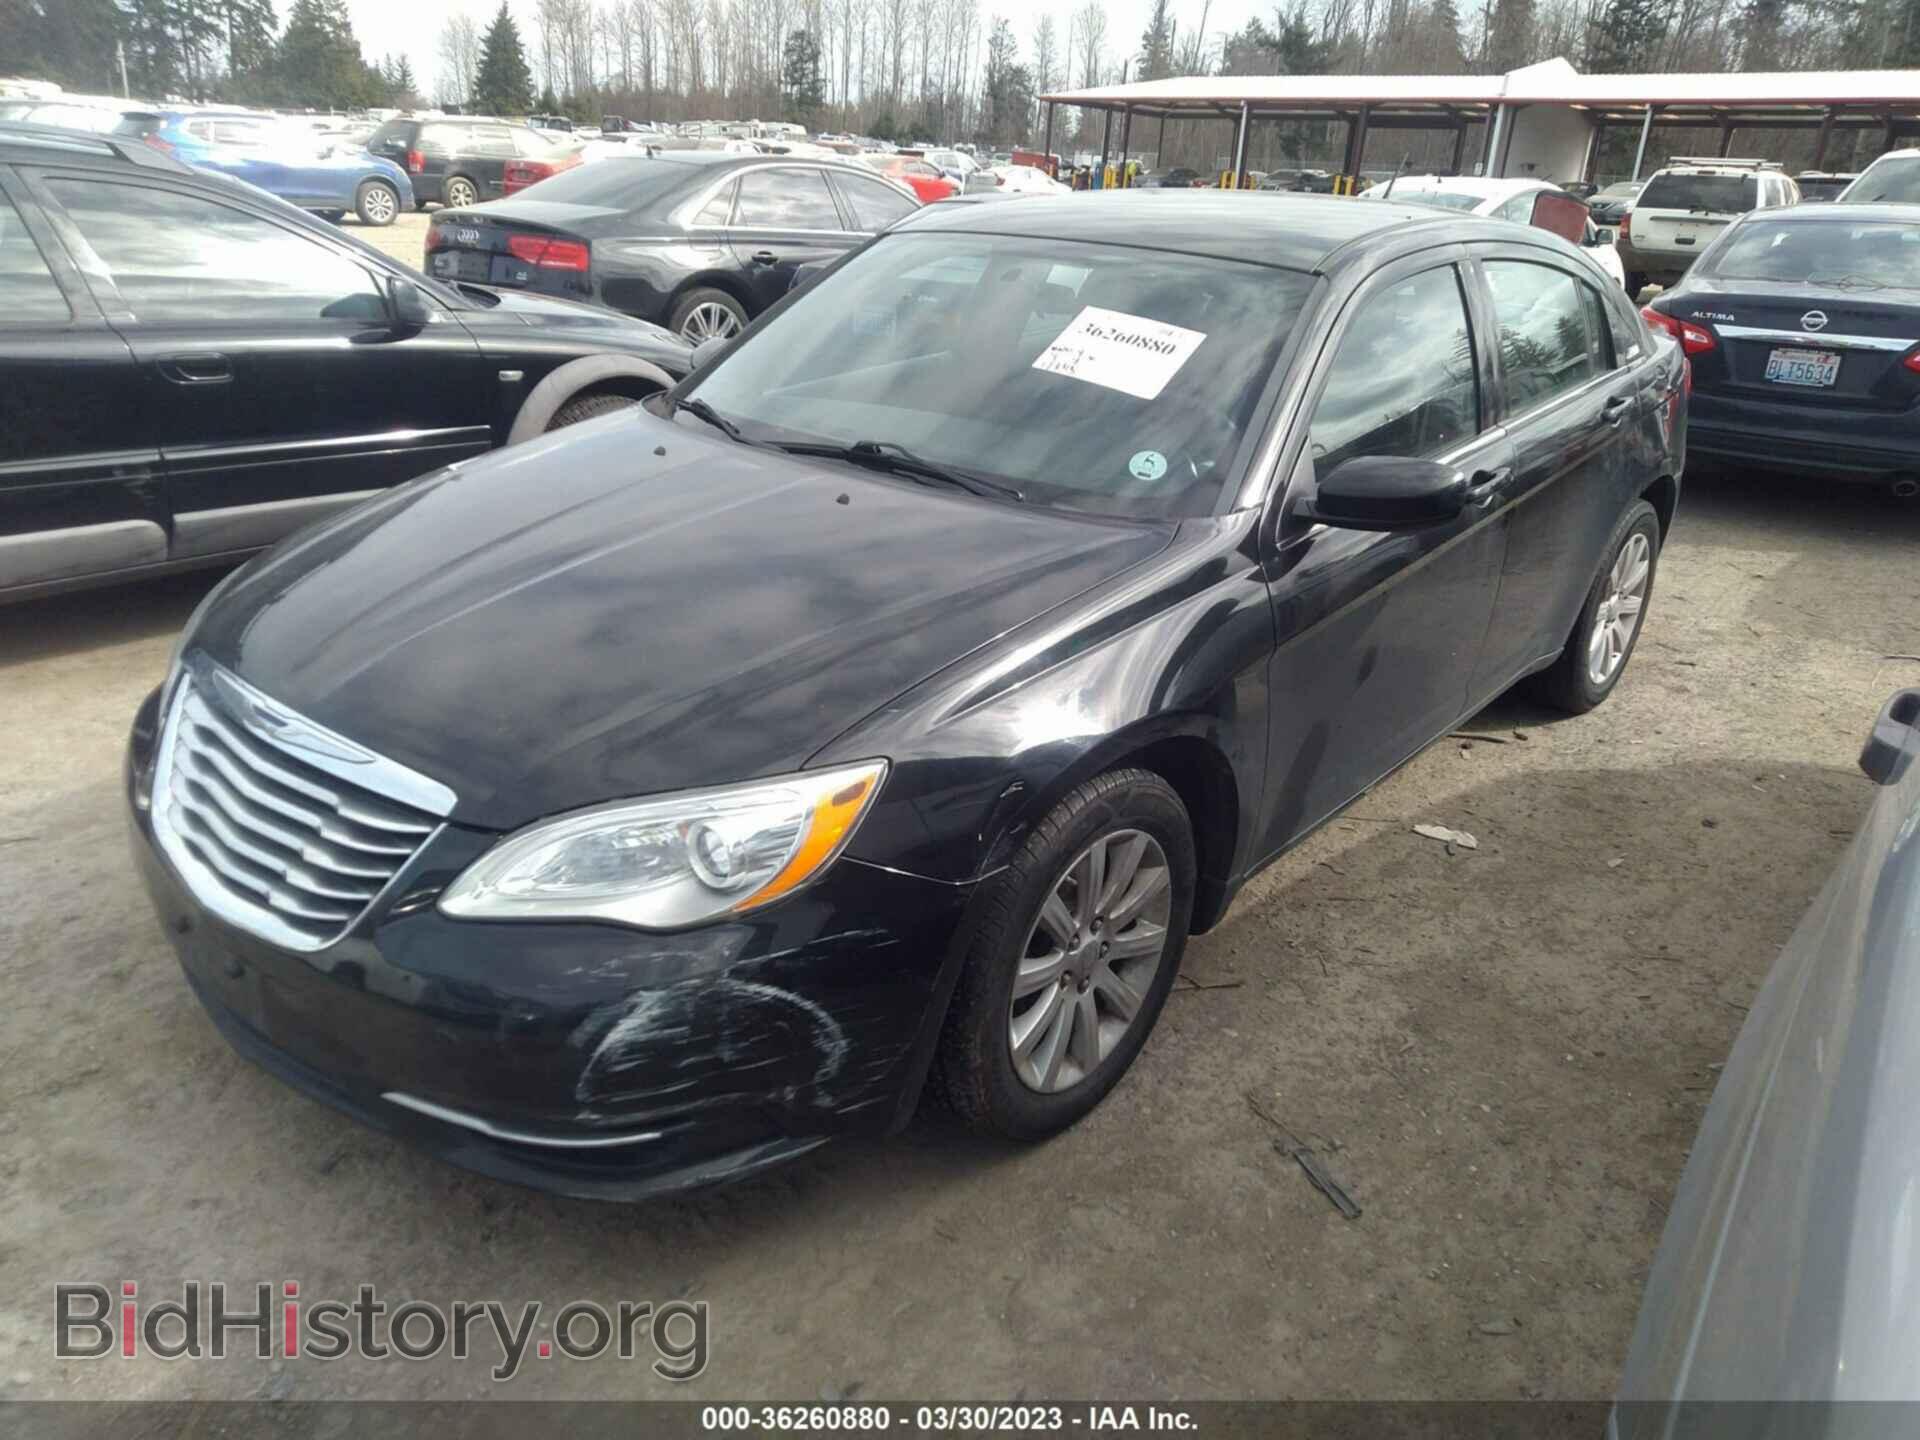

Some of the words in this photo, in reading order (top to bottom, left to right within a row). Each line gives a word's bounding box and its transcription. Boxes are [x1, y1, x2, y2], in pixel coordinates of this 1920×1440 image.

[1691, 311, 1735, 321] ALTIMA
[1084, 322, 1177, 356] 36260880
[1766, 359, 1834, 381] BLT5634
